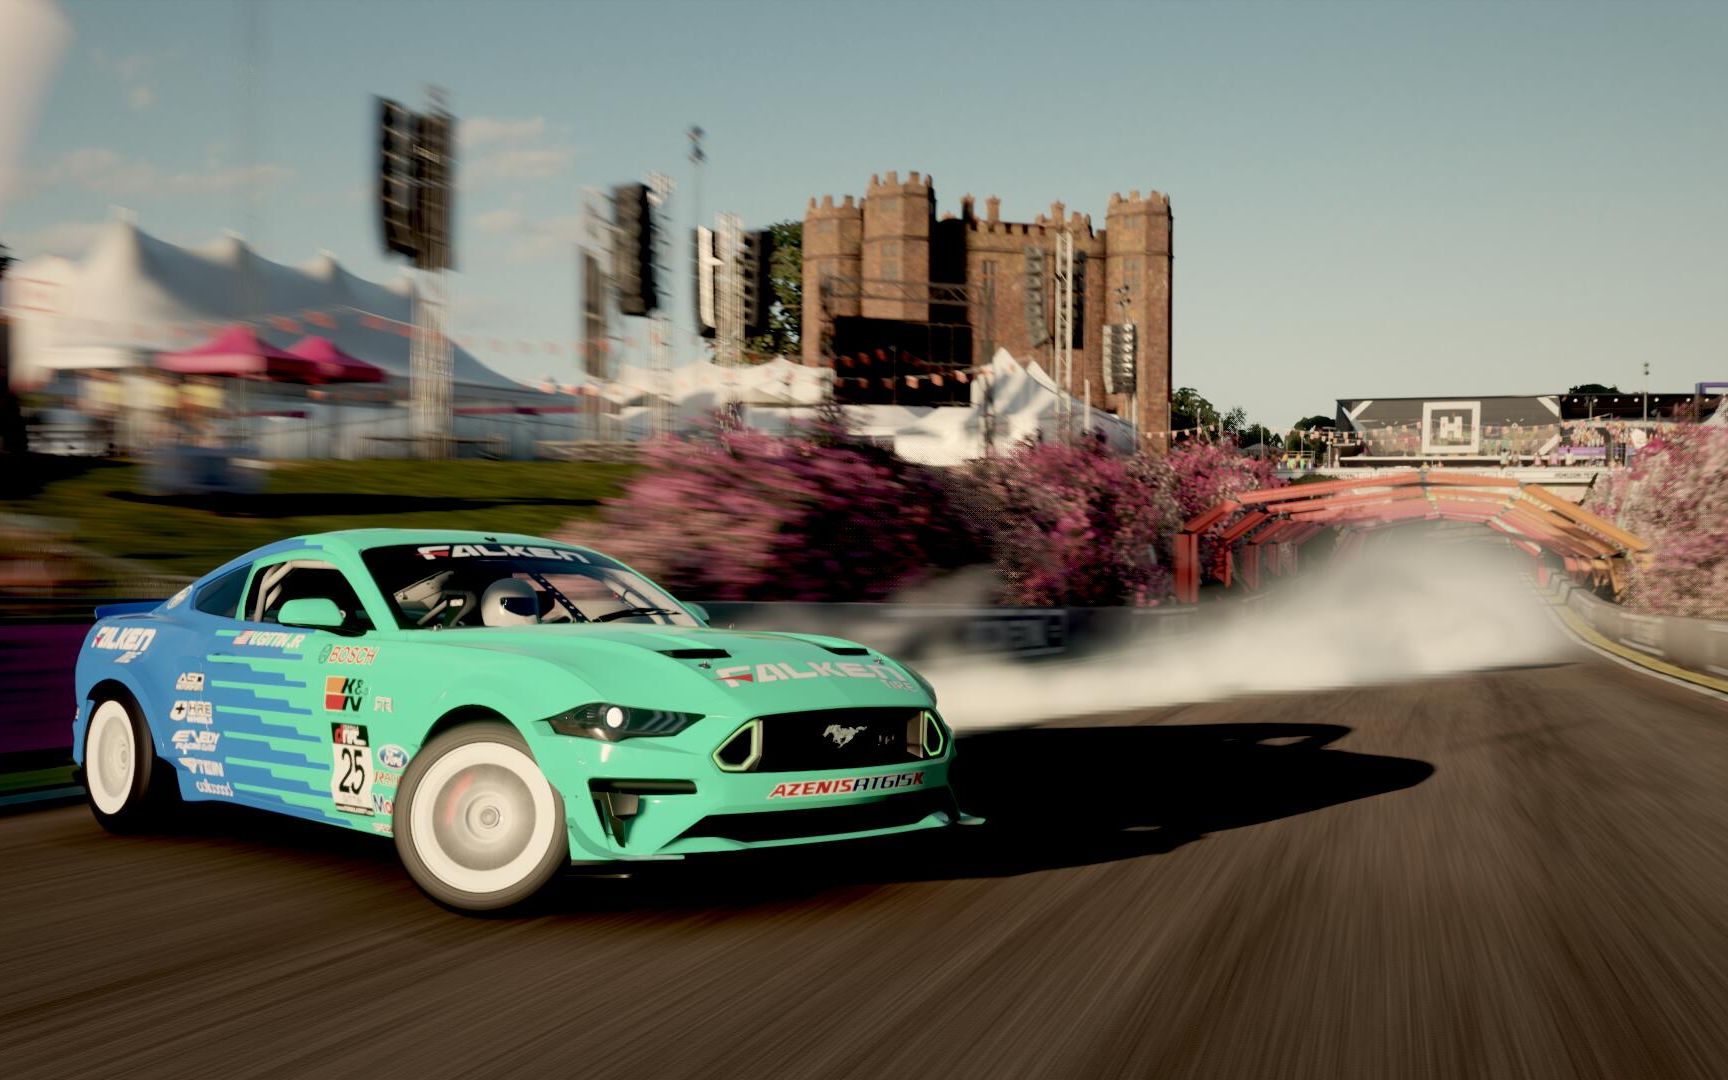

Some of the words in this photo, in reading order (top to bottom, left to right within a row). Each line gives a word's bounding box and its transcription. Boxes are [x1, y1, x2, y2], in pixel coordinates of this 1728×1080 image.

[1440, 415, 1463, 439] H
[416, 544, 590, 563] FALKEN
[91, 626, 157, 651] FALKEN
[327, 645, 380, 665] BOSCH
[714, 661, 908, 688] FALKEN
[188, 702, 211, 713] HRE
[338, 748, 365, 795] 25
